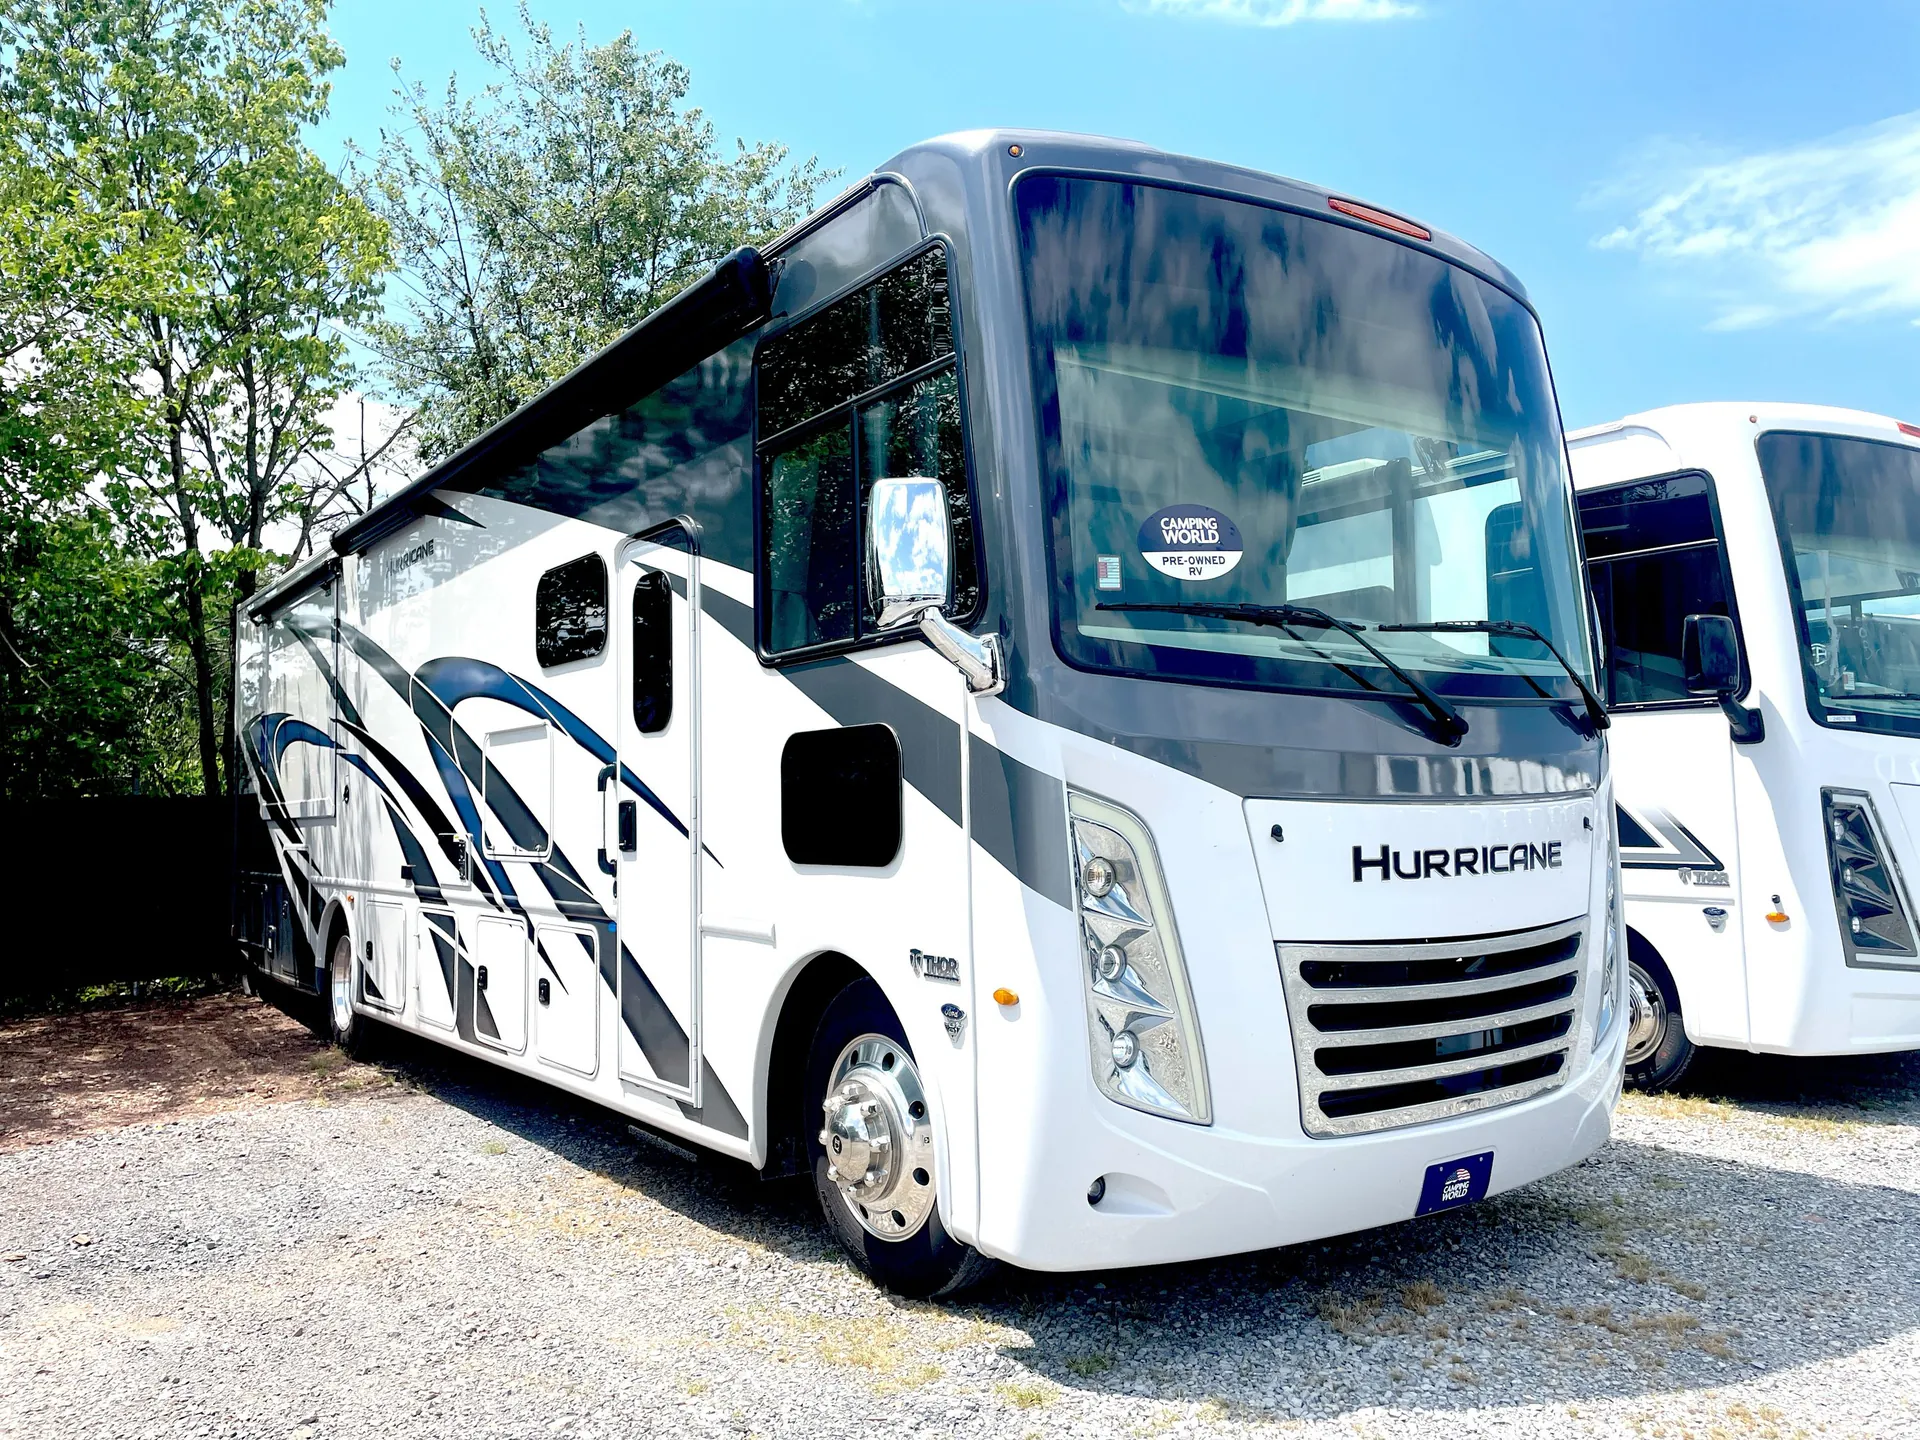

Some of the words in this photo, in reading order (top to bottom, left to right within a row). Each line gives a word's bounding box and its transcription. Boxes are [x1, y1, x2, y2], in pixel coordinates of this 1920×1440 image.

[1160, 517, 1218, 530] CAMPING
[1162, 529, 1220, 544] WORLD
[385, 538, 434, 579] HURRICANE
[1162, 556, 1226, 566] PRE-OWNED
[1189, 567, 1203, 576] RV
[1352, 840, 1562, 882] HURRICANE
[1693, 871, 1730, 885] THOR
[923, 954, 960, 978] THOR
[1443, 1181, 1470, 1194] CAMPING
[1442, 1188, 1468, 1201] WORLD
